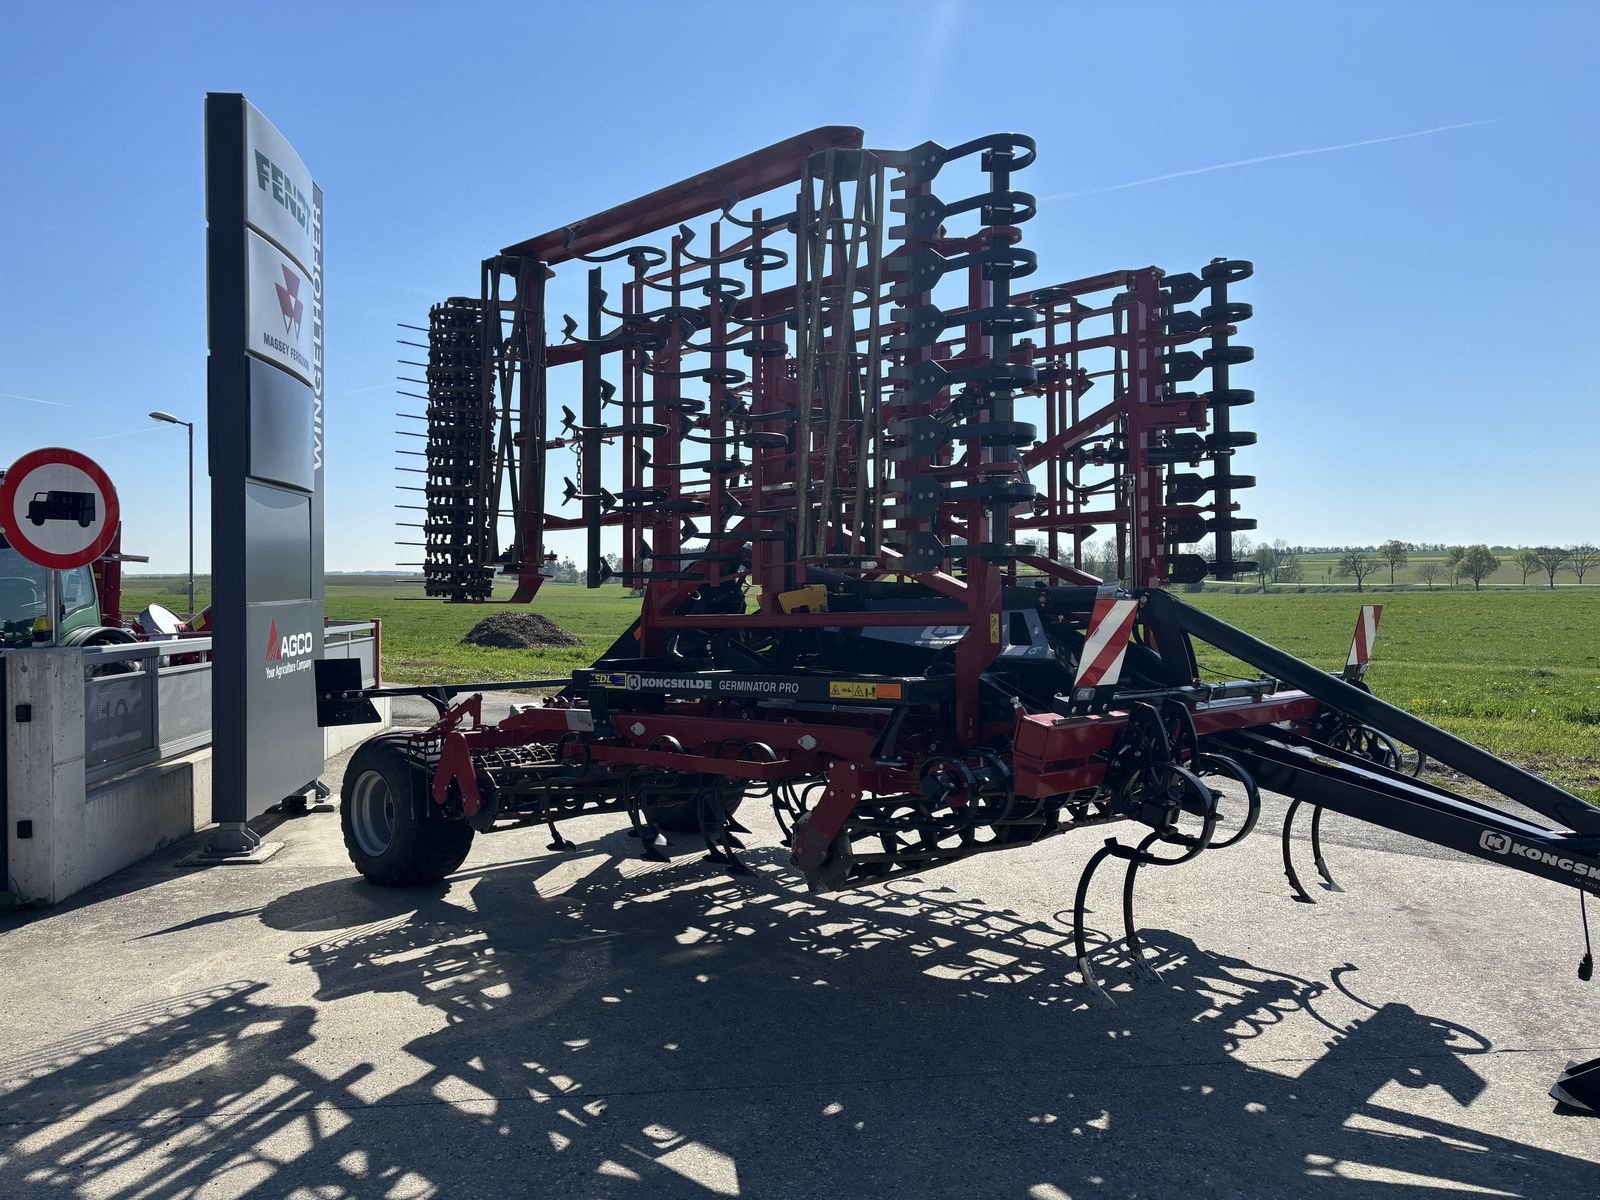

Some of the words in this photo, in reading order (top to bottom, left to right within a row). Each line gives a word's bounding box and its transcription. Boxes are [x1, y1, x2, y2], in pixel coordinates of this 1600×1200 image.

[254, 148, 311, 236] FENDT
[263, 332, 290, 356] MASSEY
[290, 347, 309, 372] FERGUSON
[313, 203, 321, 470] WINGELHOFER
[281, 631, 313, 658] AGCO
[265, 667, 275, 679] Your
[296, 659, 312, 672] Company
[641, 677, 712, 689] KONGSKILDE
[719, 680, 776, 692] GERMINATOR
[778, 682, 799, 694] PRO
[1511, 842, 1600, 880] KONGSK
